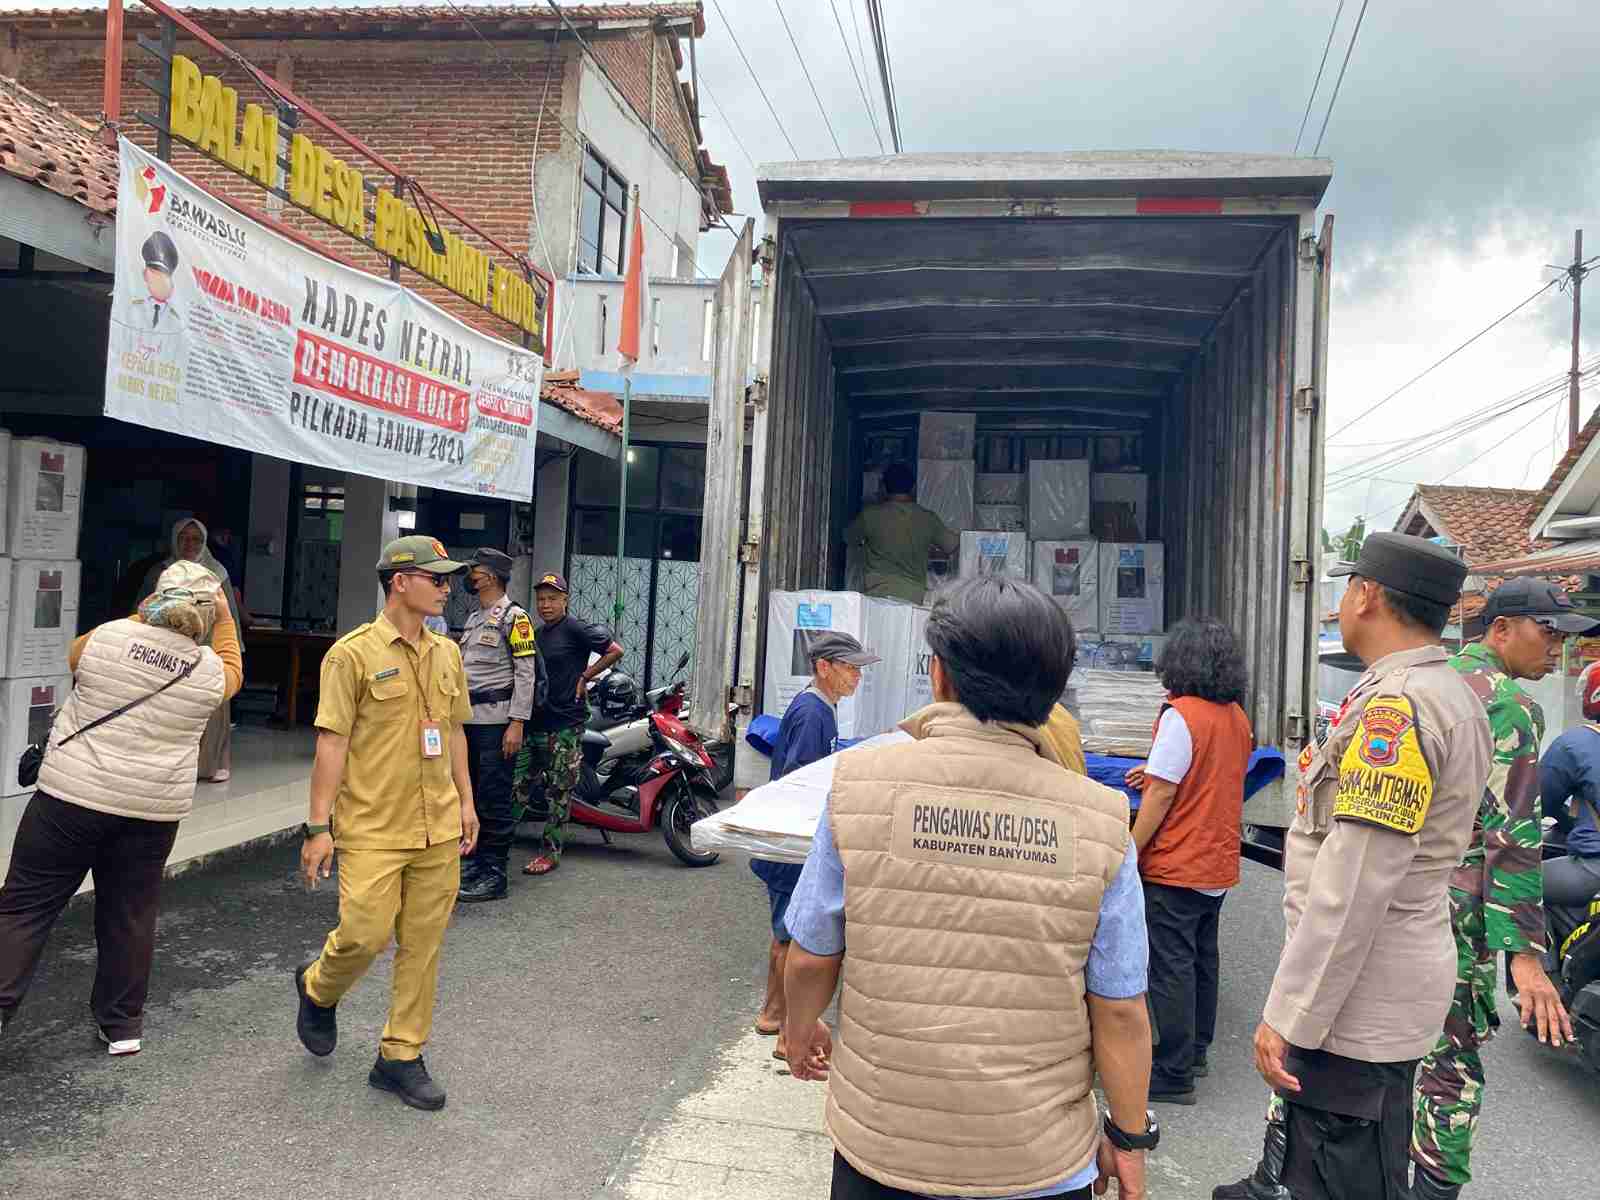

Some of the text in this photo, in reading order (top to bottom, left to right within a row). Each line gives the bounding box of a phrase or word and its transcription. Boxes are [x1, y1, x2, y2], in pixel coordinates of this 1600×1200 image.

[170, 55, 279, 188] BALAI
[290, 133, 365, 238] DESA
[171, 192, 246, 248] BAWASLU
[302, 276, 387, 351] KADES
[400, 320, 472, 386] NETRAL
[301, 339, 411, 409] DEMOKRASI
[417, 383, 457, 422] KUAT
[290, 391, 368, 443] PILKADA
[376, 416, 424, 457] TAHUN
[429, 432, 464, 465] 2024
[128, 643, 178, 672] PENGAWAS
[913, 805, 1058, 848] PENGAWAS KEL/DESA
[913, 838, 1057, 864] KABUPATEN BANYUMAS
